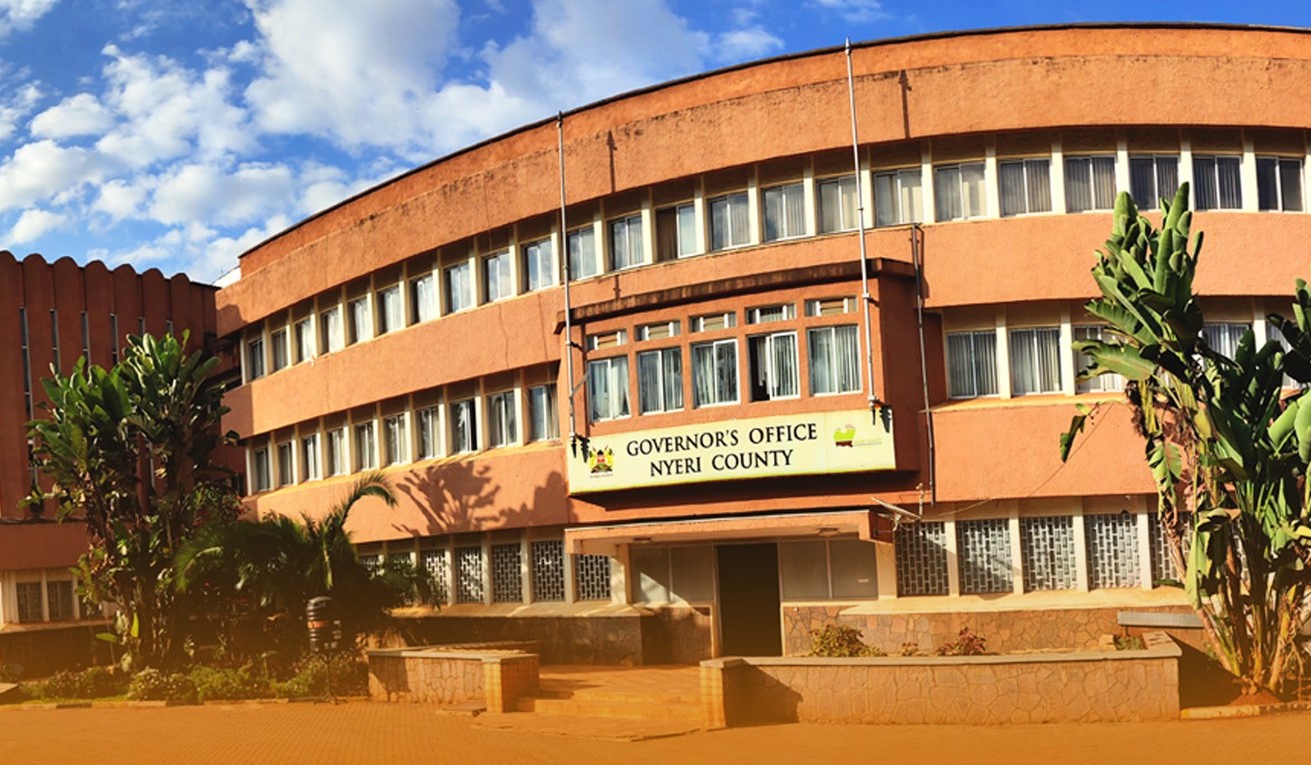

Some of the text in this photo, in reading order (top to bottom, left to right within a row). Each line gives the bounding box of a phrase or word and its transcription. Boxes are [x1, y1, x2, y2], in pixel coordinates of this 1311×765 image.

[626, 423, 818, 457] GOVERNOR'S OFFICE
[650, 449, 794, 477] NYERI COUNTY
